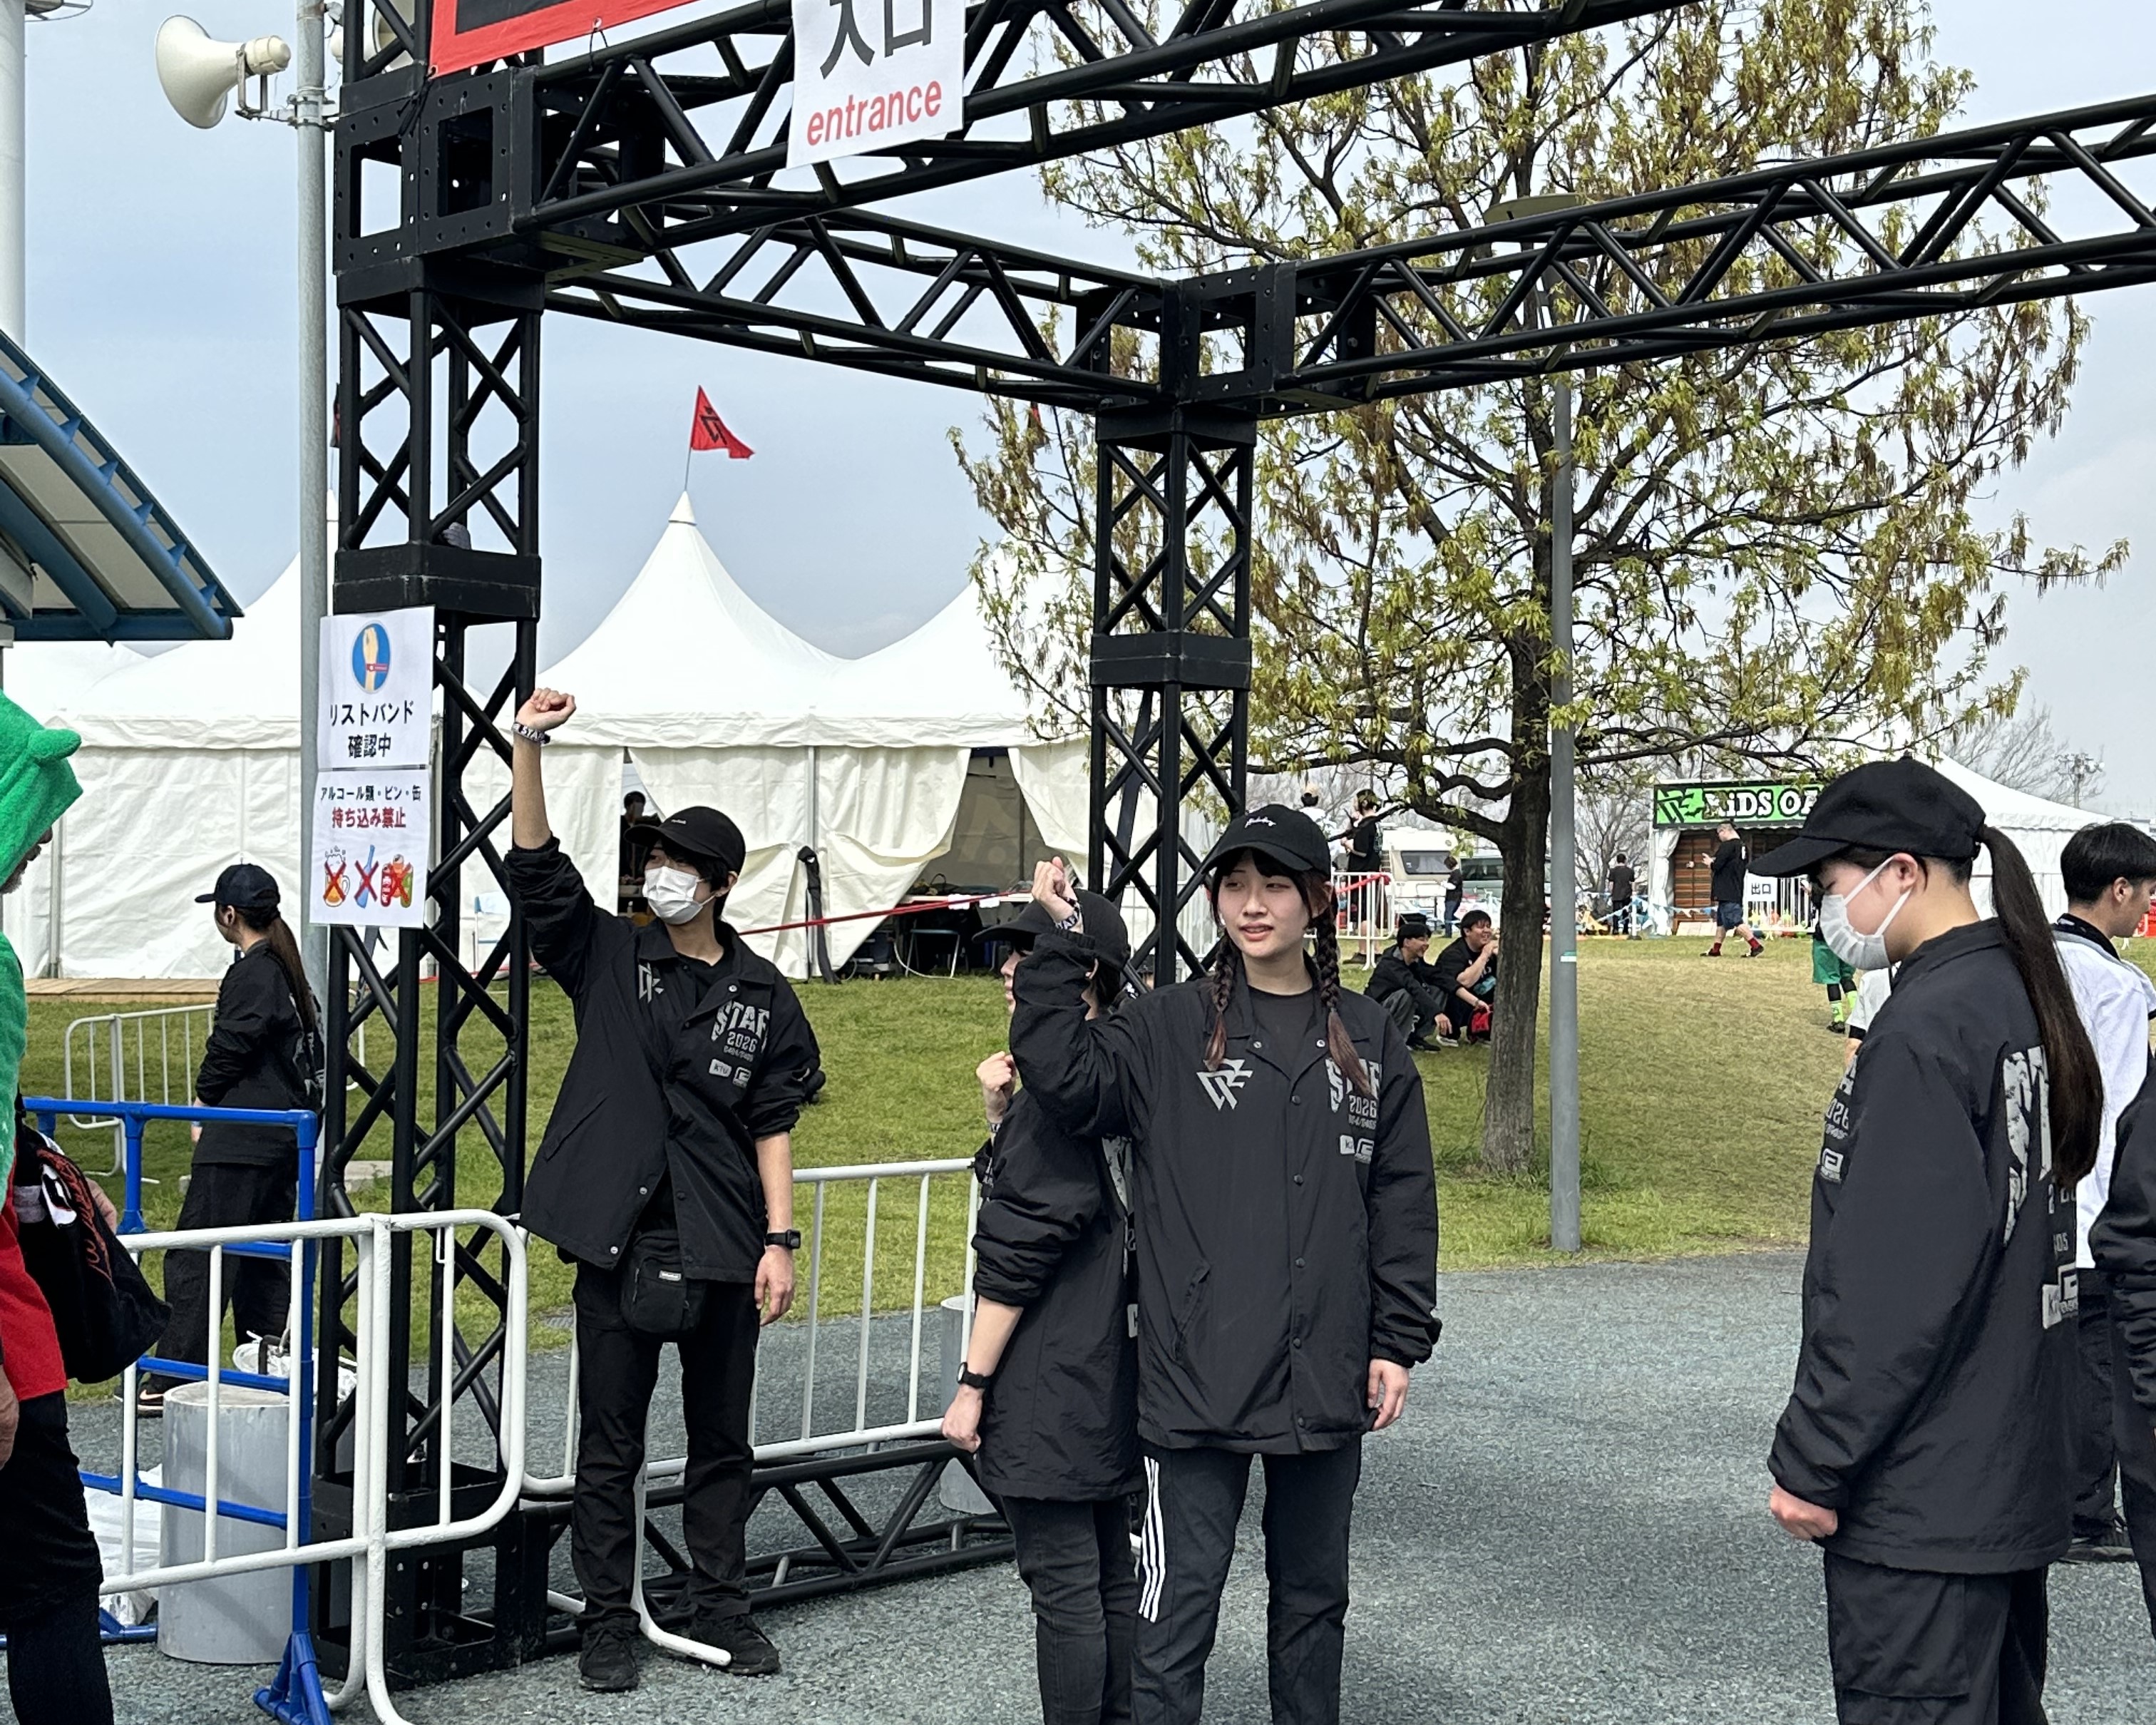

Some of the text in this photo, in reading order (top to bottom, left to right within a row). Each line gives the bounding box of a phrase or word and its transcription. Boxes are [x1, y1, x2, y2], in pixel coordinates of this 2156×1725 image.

[820, 0, 932, 80] 入口
[807, 81, 942, 146] entrance
[330, 700, 414, 727] リストバンド
[348, 732, 391, 759] 確認中
[332, 807, 406, 829] 持ち込み禁止
[1751, 882, 1772, 896] 出口
[711, 1000, 770, 1053] STAF
[727, 1031, 758, 1053] 2026
[1348, 1095, 1377, 1118] 2026
